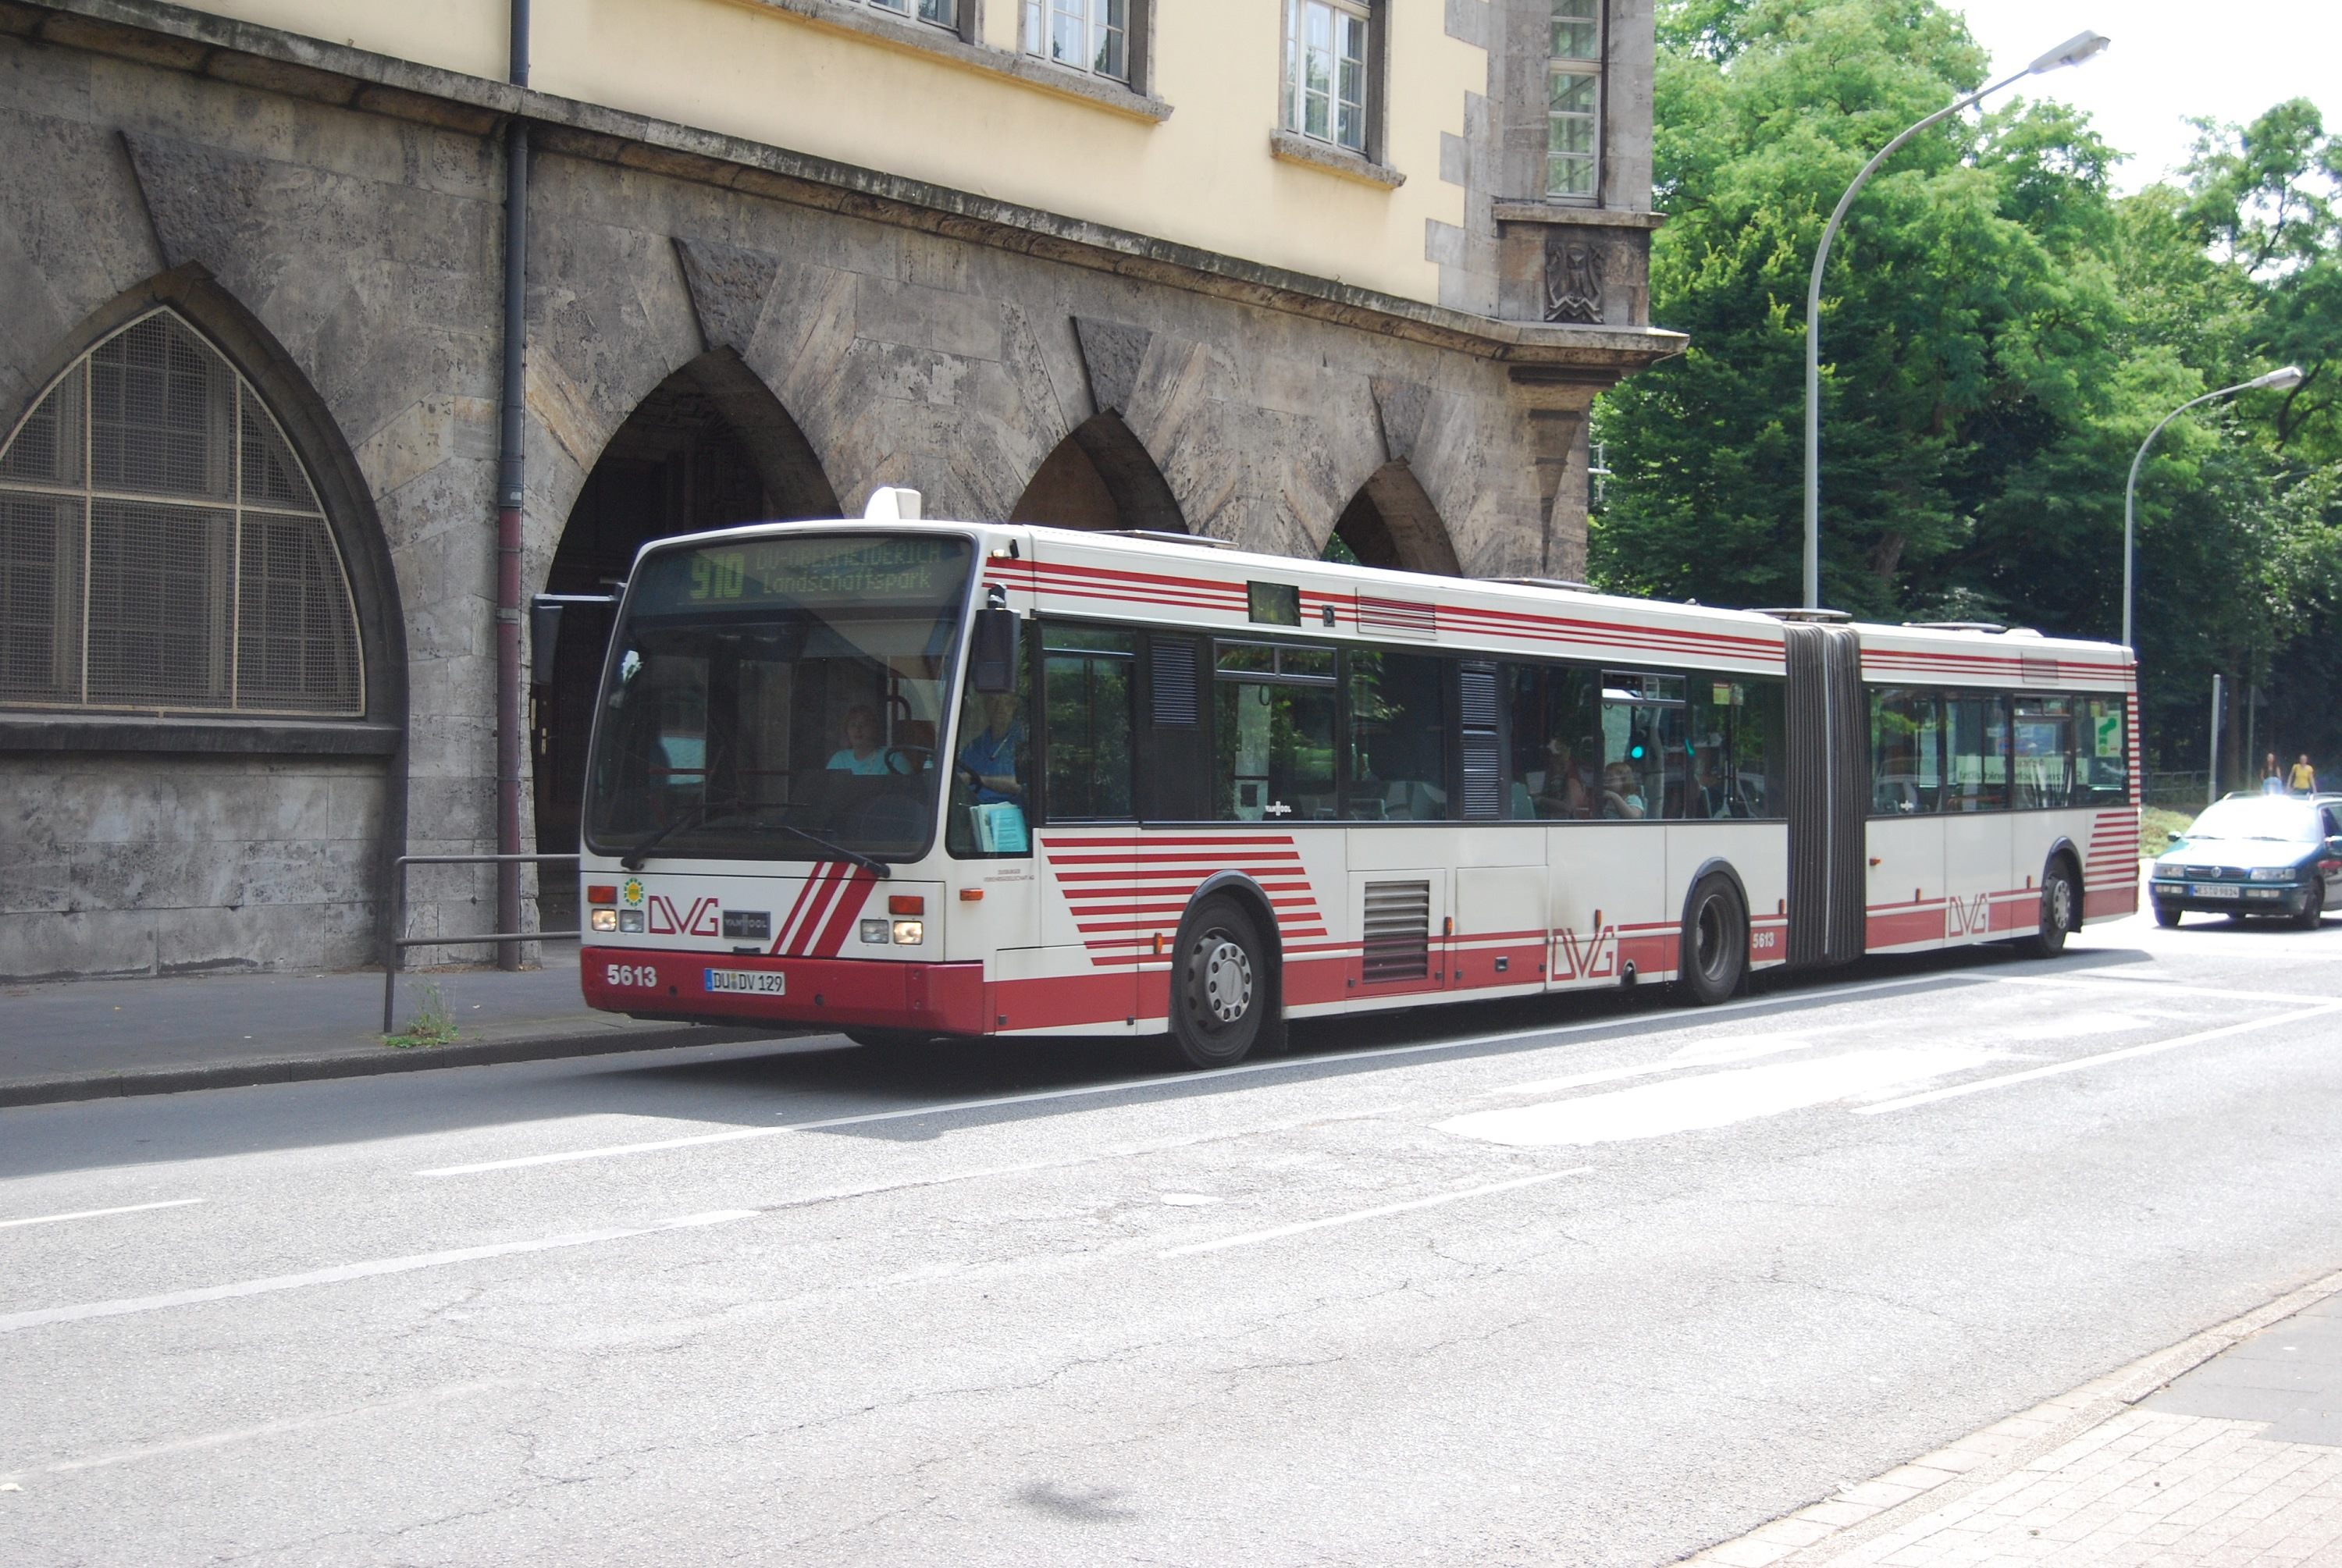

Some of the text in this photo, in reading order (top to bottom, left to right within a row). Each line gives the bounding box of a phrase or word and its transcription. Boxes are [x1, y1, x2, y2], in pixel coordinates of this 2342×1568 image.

[691, 552, 745, 599] 910
[763, 566, 932, 594] Landschaftspark
[649, 895, 719, 937] DVG
[1949, 893, 1987, 937] DVG
[1551, 925, 1614, 982] DVG
[1753, 931, 1774, 949] 5613
[607, 964, 657, 987] 5613
[713, 972, 783, 992] DU DV 129
